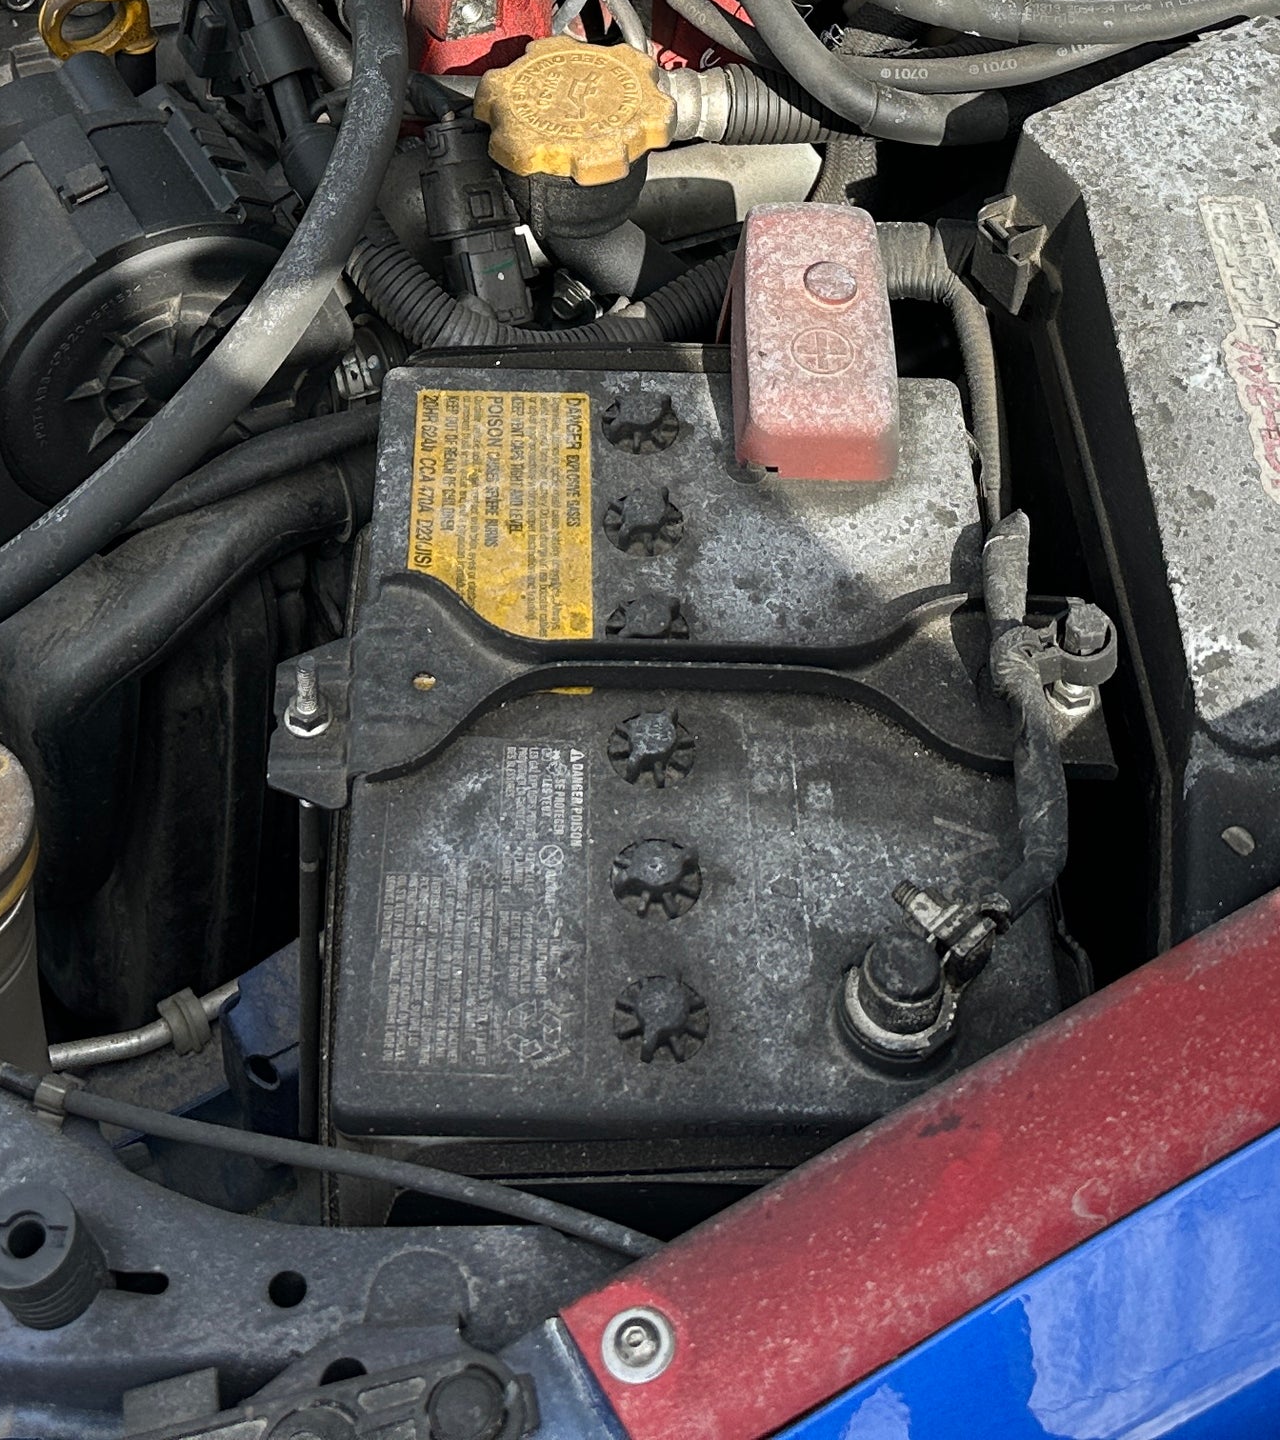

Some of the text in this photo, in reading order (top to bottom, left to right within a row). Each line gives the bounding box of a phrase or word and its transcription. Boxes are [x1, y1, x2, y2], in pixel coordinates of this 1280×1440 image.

[486, 395, 504, 448] POISON
[566, 397, 583, 450] DANGER
[419, 458, 437, 482] CCA
